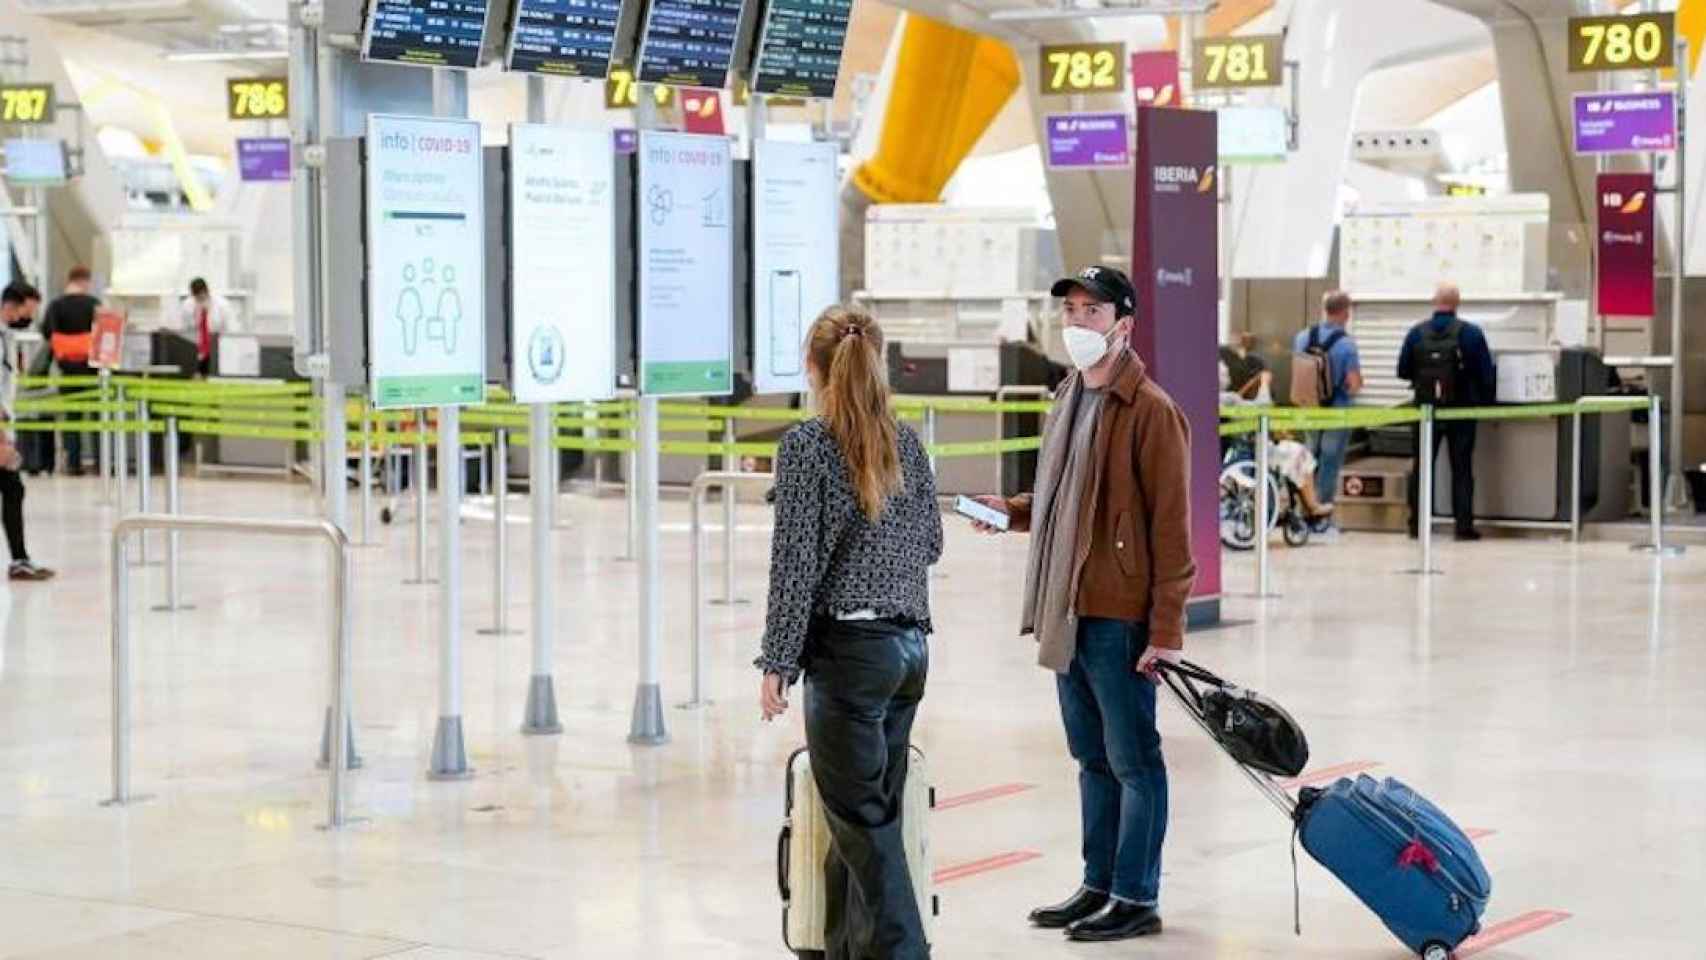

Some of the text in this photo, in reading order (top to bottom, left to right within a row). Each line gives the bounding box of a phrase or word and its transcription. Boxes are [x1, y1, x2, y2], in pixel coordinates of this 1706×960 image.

[1580, 22, 1661, 64] 780
[1048, 51, 1115, 88] 782
[1204, 43, 1269, 82] 781
[2, 89, 46, 120] 787
[233, 82, 286, 114] 786
[1154, 165, 1198, 182] IBERIA
